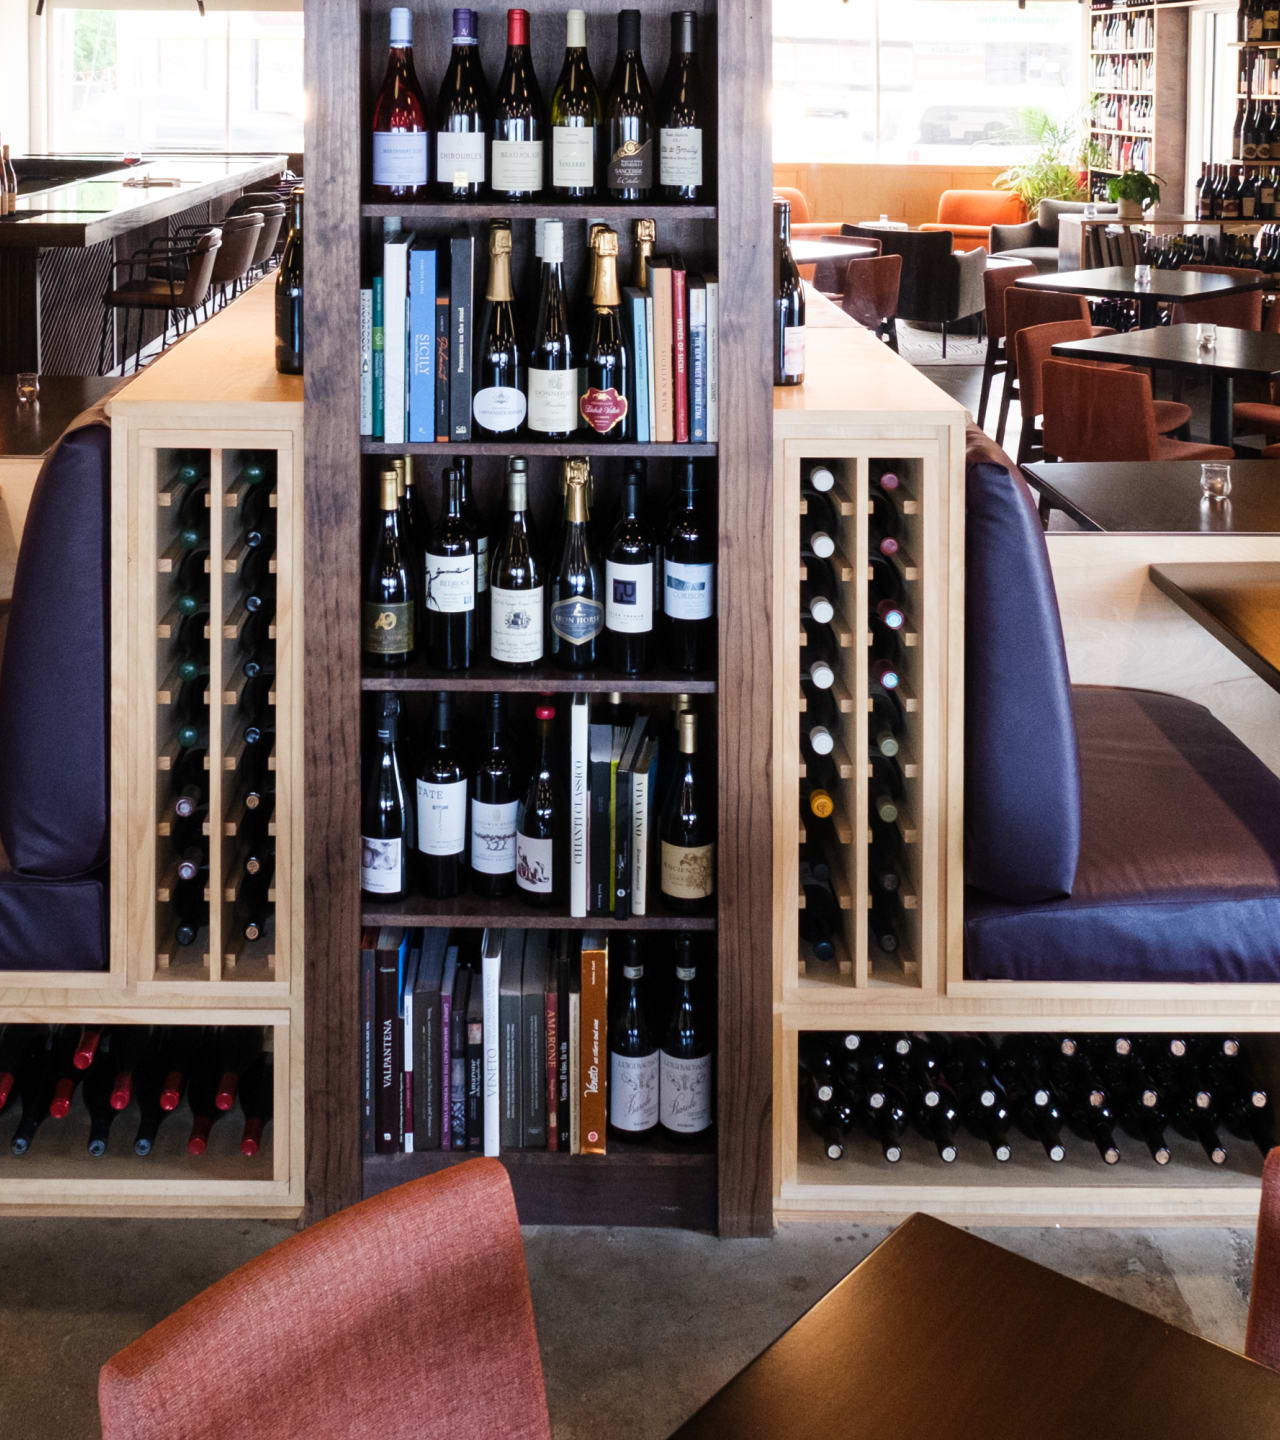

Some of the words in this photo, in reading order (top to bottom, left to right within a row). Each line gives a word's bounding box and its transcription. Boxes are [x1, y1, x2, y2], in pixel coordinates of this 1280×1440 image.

[676, 319, 685, 341] WINES
[677, 343, 685, 351] OF
[418, 334, 430, 376] SICILY
[677, 353, 685, 374] SICILY
[555, 615, 574, 625] IRON
[576, 615, 601, 625] HORSE
[575, 760, 584, 810] CLASSICO
[574, 813, 584, 864] CHIANTI
[383, 1019, 393, 1088] VALPANTENA
[547, 1010, 556, 1068] AMARONE
[487, 1049, 497, 1097] VENETO
